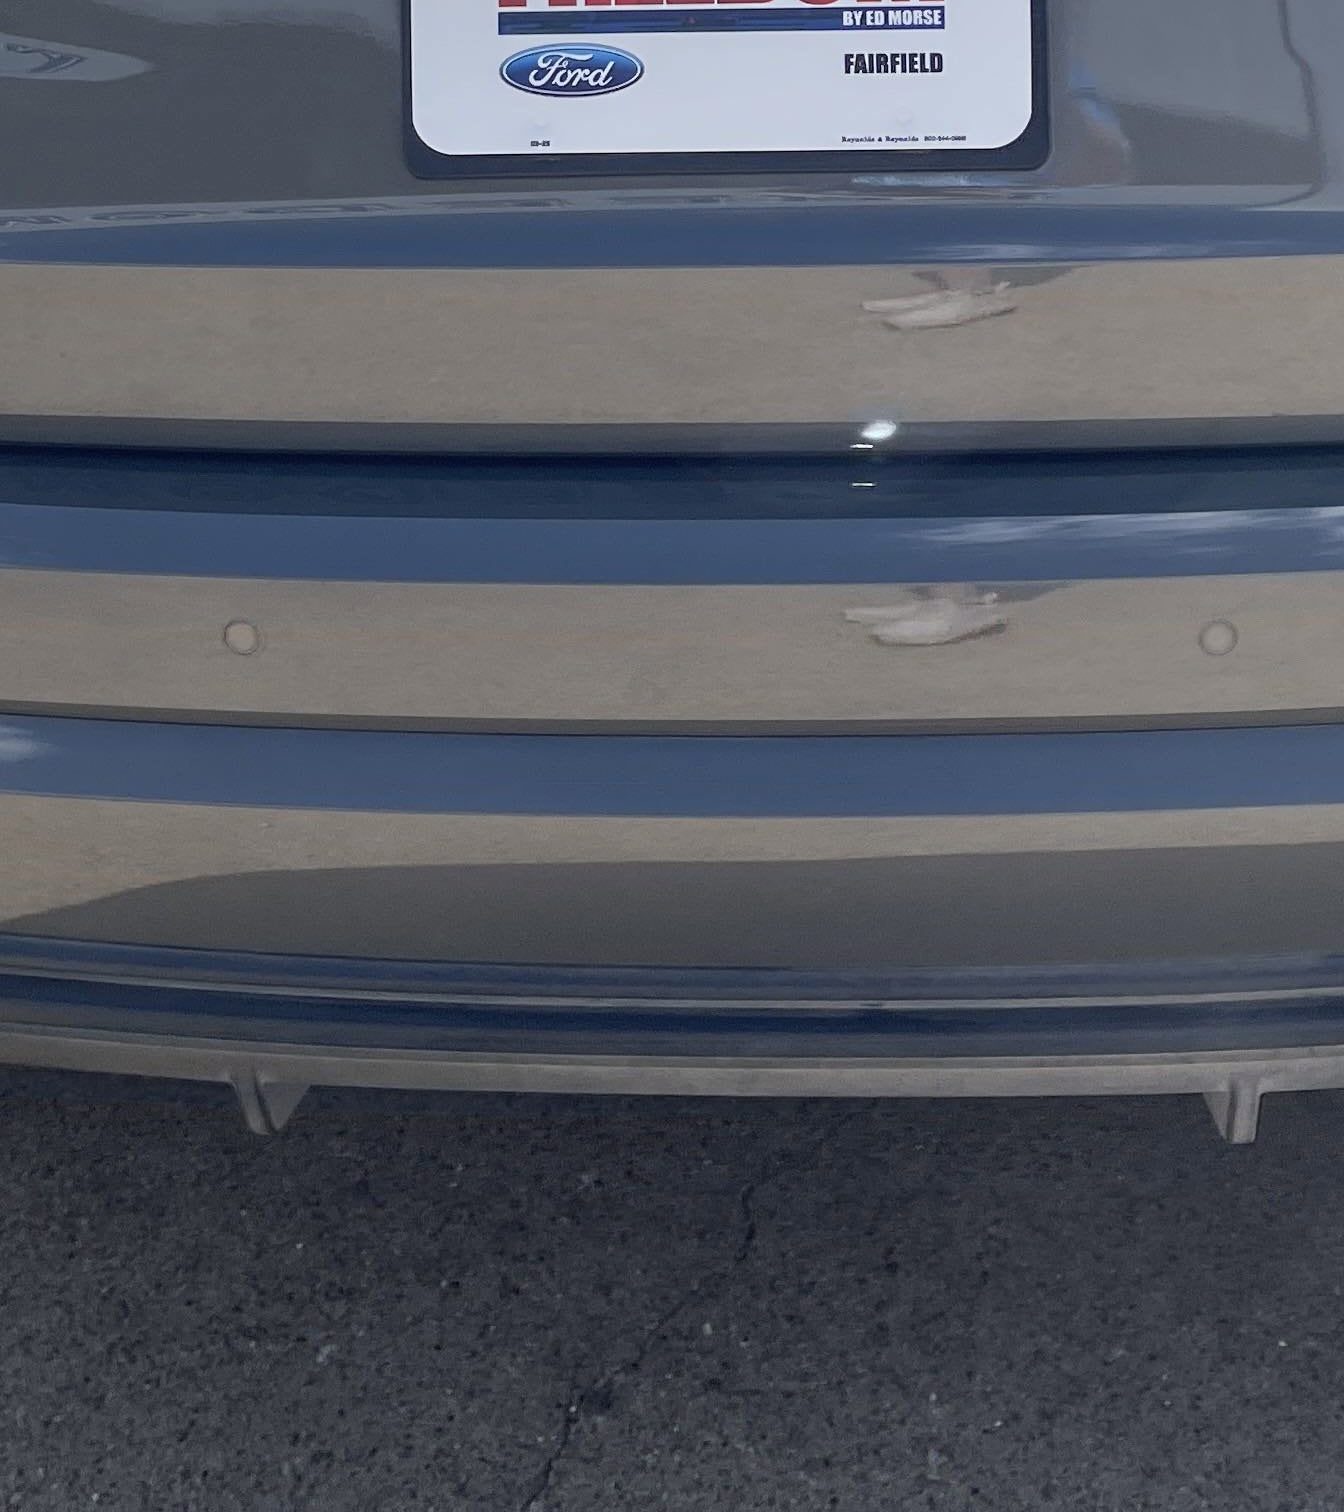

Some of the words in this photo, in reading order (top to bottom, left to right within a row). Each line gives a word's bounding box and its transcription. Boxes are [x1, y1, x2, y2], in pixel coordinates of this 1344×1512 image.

[842, 10, 862, 26] BY
[865, 9, 885, 26] ED
[887, 9, 942, 26] MORSE
[528, 51, 615, 87] Ford
[844, 52, 944, 75] FAIRFIELD
